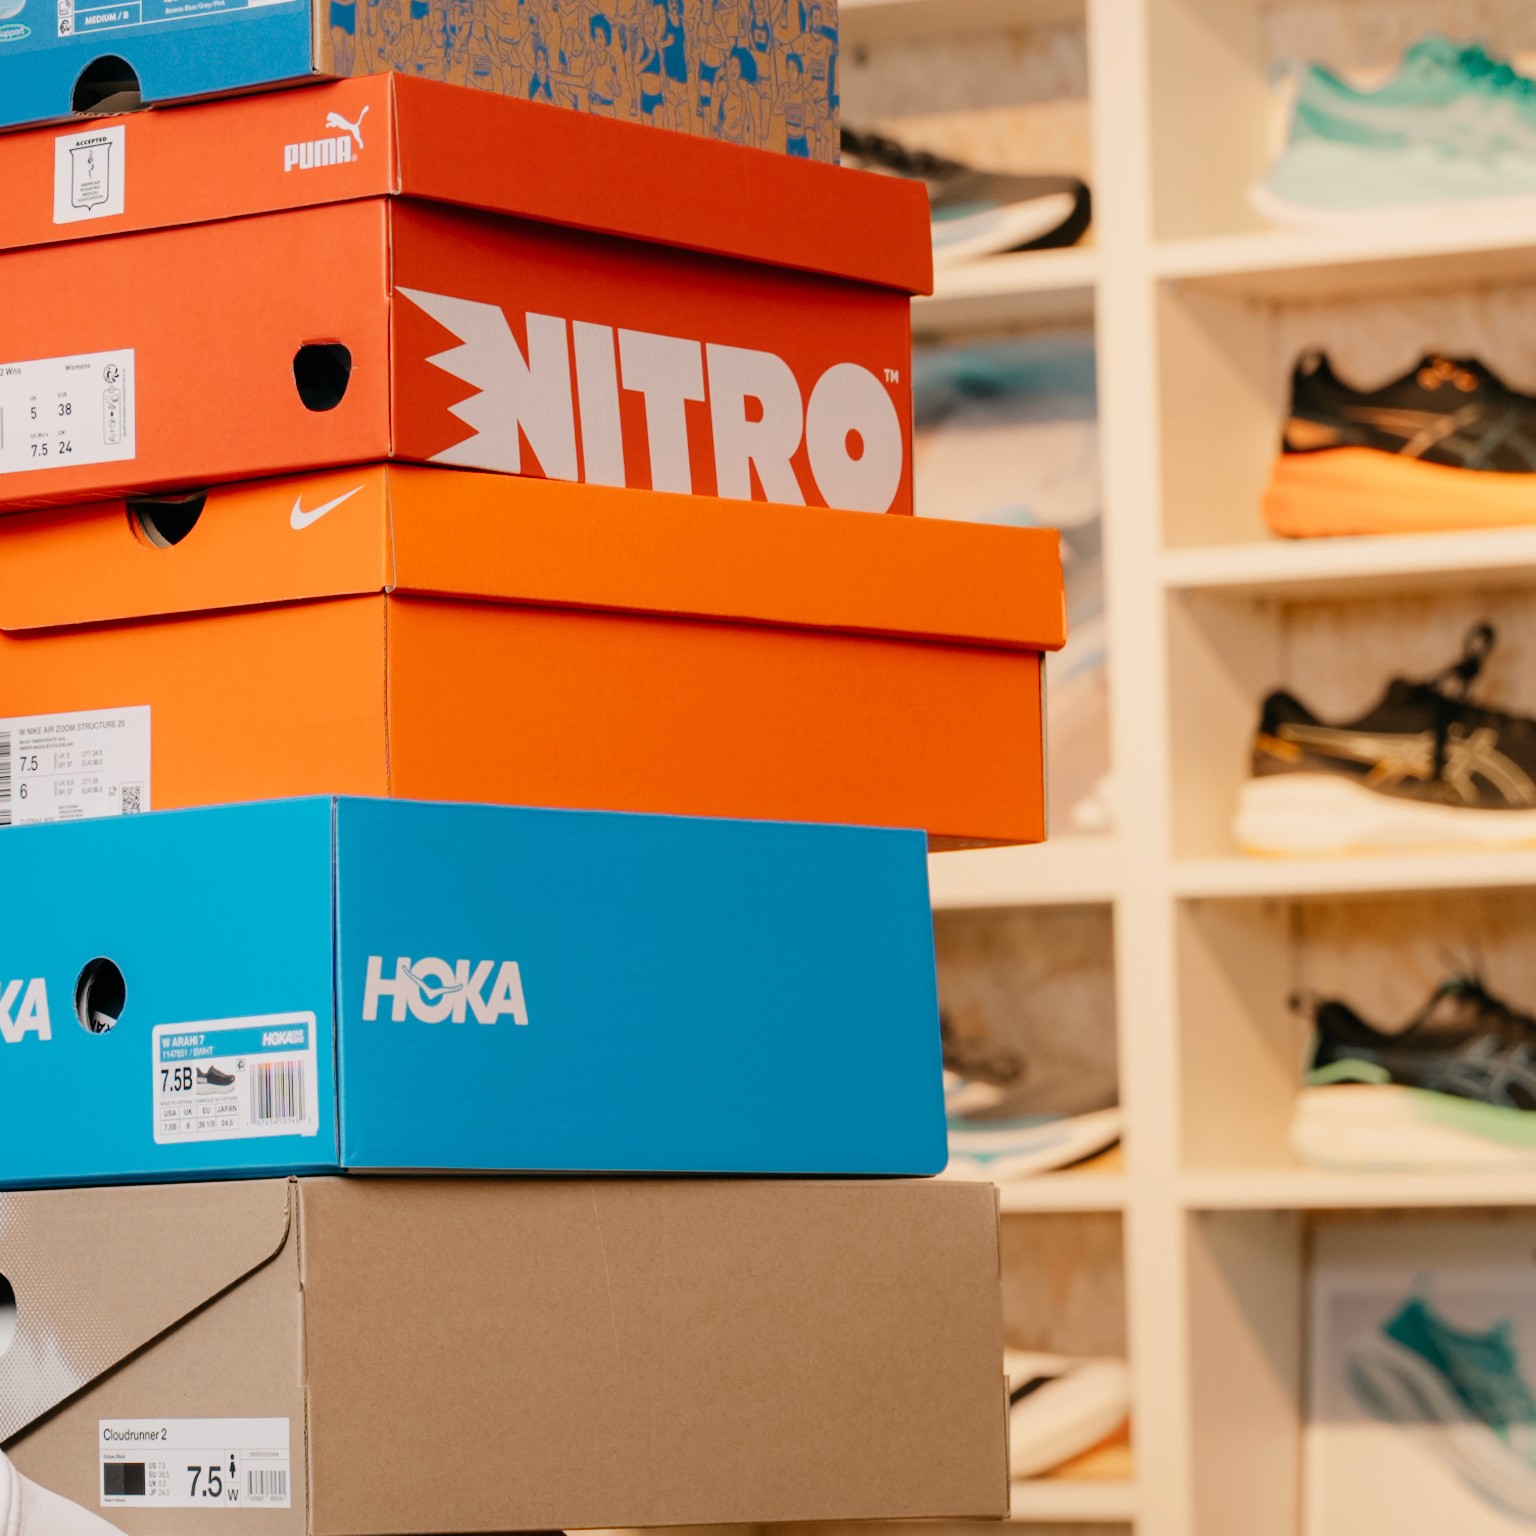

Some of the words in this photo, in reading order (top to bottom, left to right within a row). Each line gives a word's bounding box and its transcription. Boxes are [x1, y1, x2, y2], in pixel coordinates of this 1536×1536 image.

[85, 14, 116, 25] MEDIUM
[76, 137, 107, 146] ACCEPTED
[5, 367, 21, 375] Wns
[31, 407, 37, 419] 5
[58, 403, 72, 416] 38
[31, 443, 48, 457] 7.5
[59, 440, 72, 454] 24
[19, 728, 26, 736] W
[27, 726, 41, 735] NIKE
[43, 724, 54, 733] AIR
[56, 722, 75, 732] ZOOM
[77, 720, 115, 731] STRUCTURE
[117, 719, 125, 727] 25
[19, 755, 38, 771] 7.5
[20, 784, 28, 799] 6
[363, 956, 529, 1025] HOKA
[162, 1037, 171, 1048] W
[172, 1035, 199, 1047] ARAHI
[199, 1034, 205, 1044] 7
[262, 1031, 293, 1046] HOKA
[161, 1066, 193, 1092] 7.5B
[164, 1109, 176, 1117] USA
[184, 1108, 192, 1116] UK
[217, 1105, 237, 1113] JAPAN
[221, 1119, 233, 1127] 24.5
[103, 1428, 159, 1441] Cloudrunner
[161, 1428, 167, 1441] 2
[187, 1466, 222, 1497] 7.5
[227, 1489, 239, 1501] W
